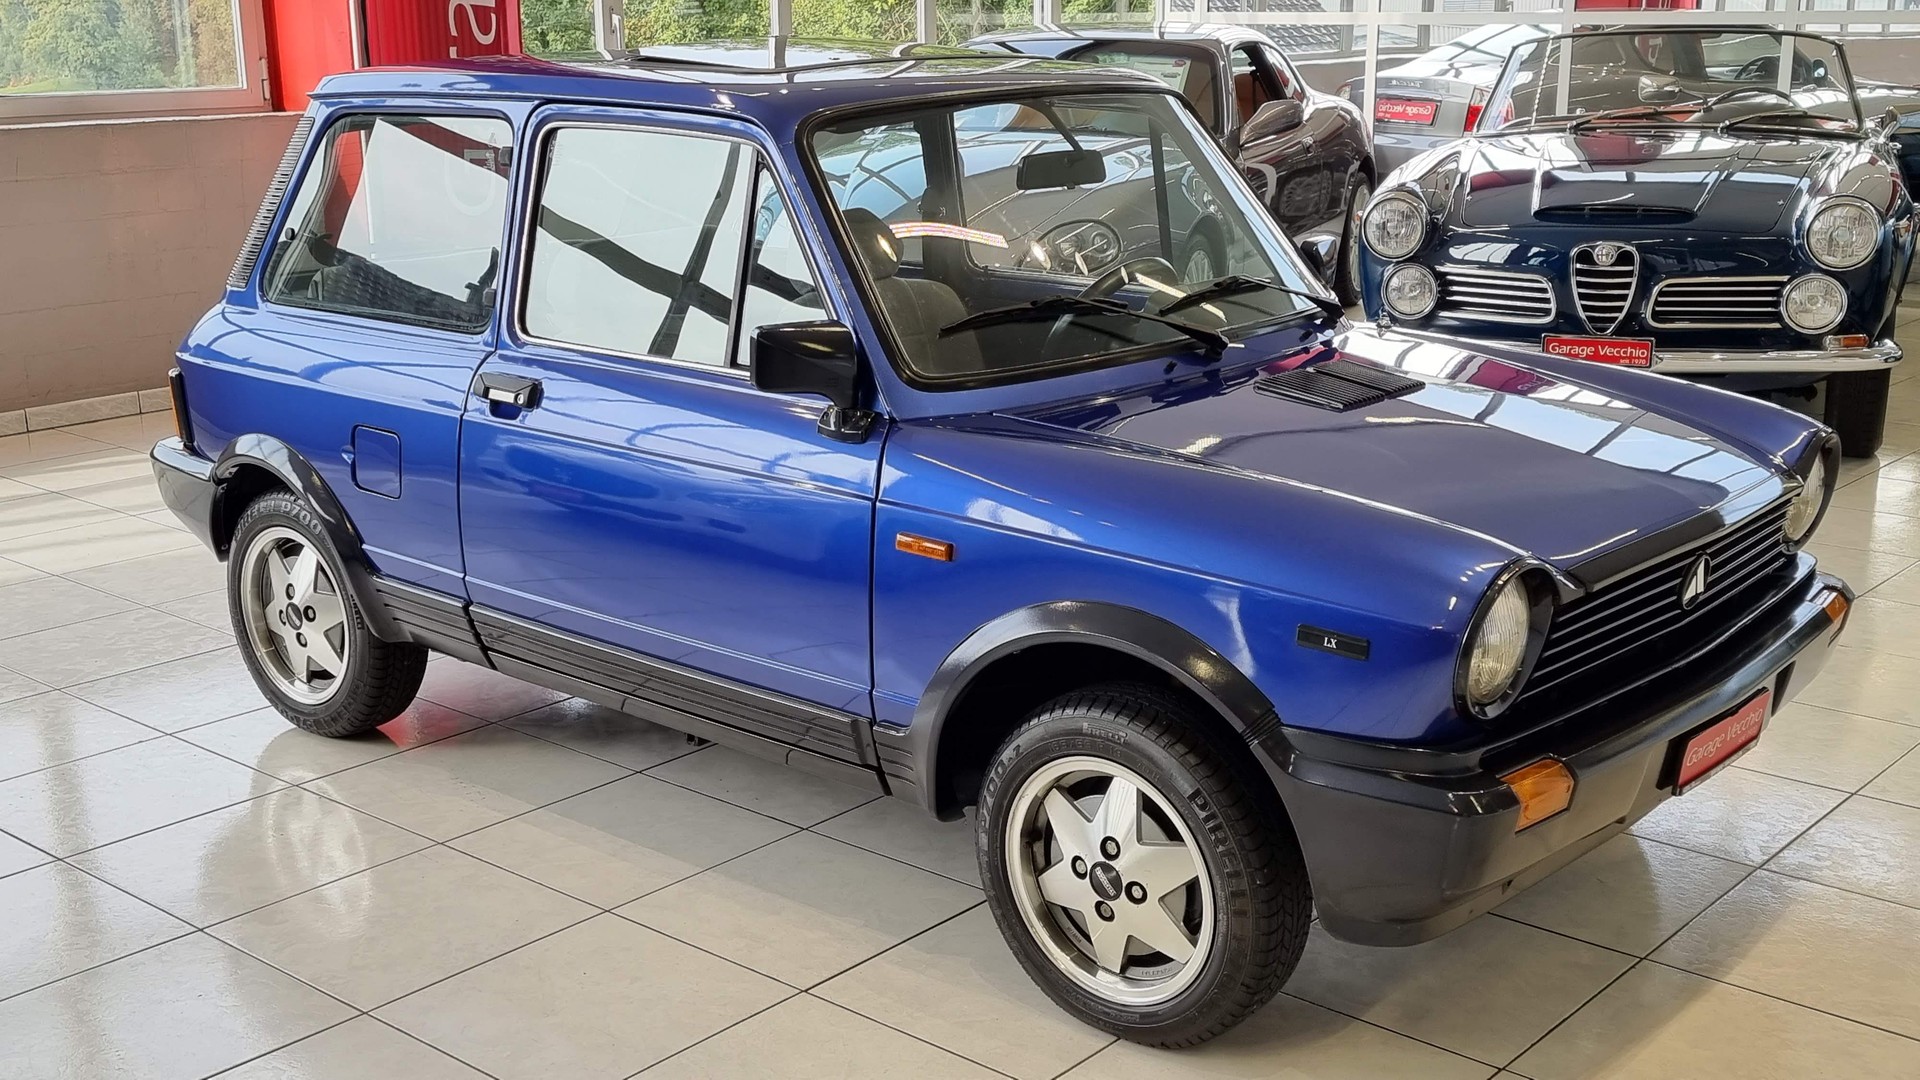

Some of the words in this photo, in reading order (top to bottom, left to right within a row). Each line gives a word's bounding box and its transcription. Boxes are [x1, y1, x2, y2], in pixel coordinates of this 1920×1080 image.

[1549, 342, 1595, 358] Garage
[1598, 344, 1648, 358] Vecchio
[1323, 636, 1338, 649] LX
[1686, 733, 1726, 767] Garage
[1727, 707, 1763, 742] Vecchio
